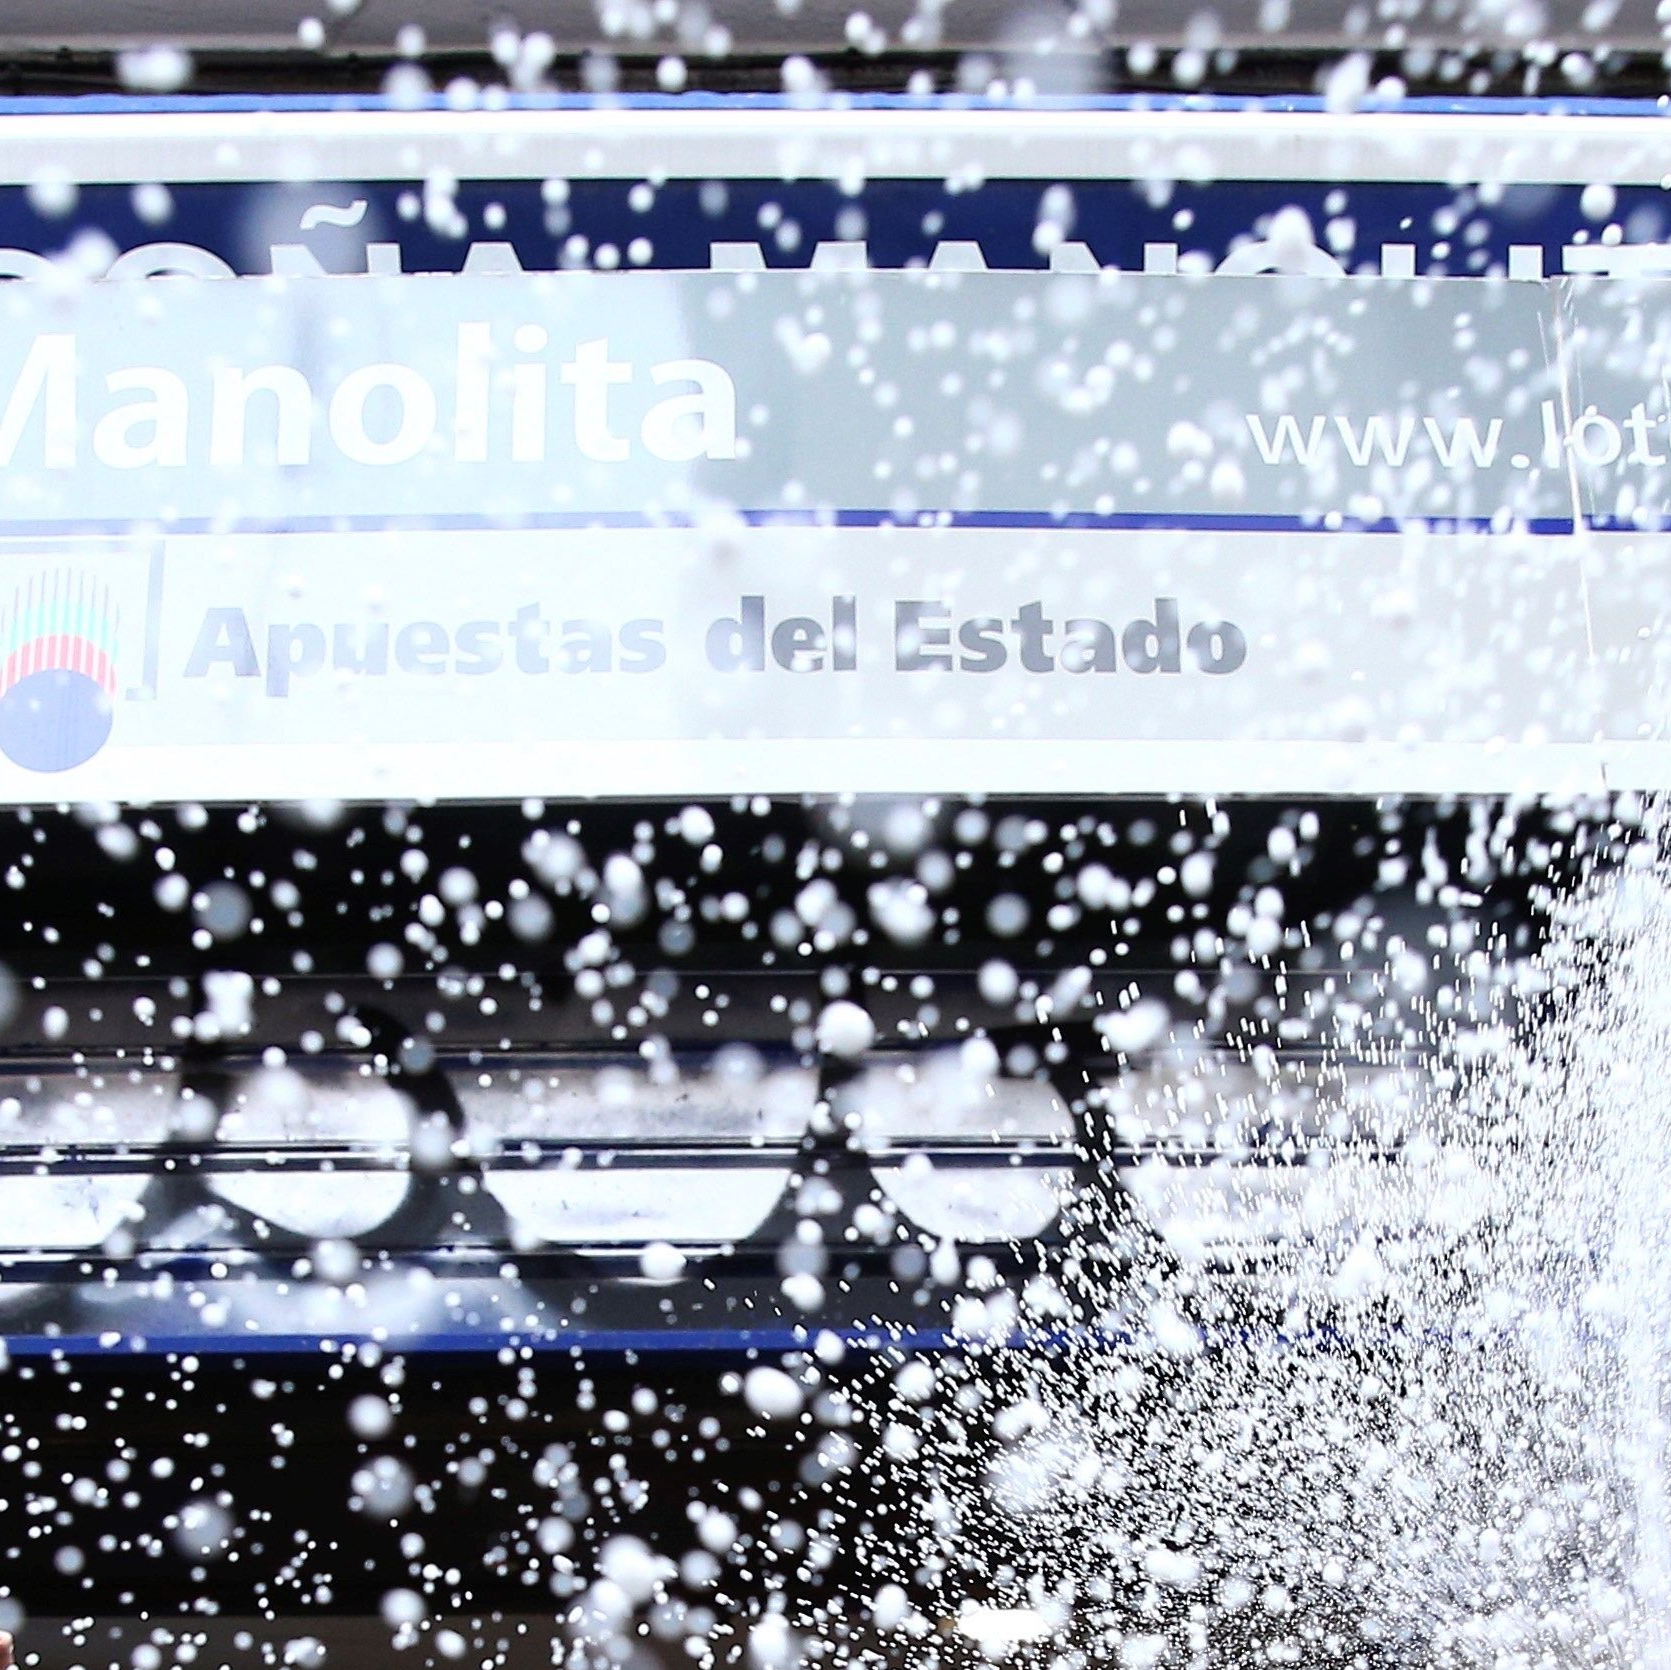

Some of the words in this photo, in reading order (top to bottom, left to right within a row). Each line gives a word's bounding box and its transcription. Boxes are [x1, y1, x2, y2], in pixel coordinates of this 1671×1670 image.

[182, 602, 668, 698] Apuestas
[705, 595, 857, 672] del
[894, 597, 1247, 675] Estado
